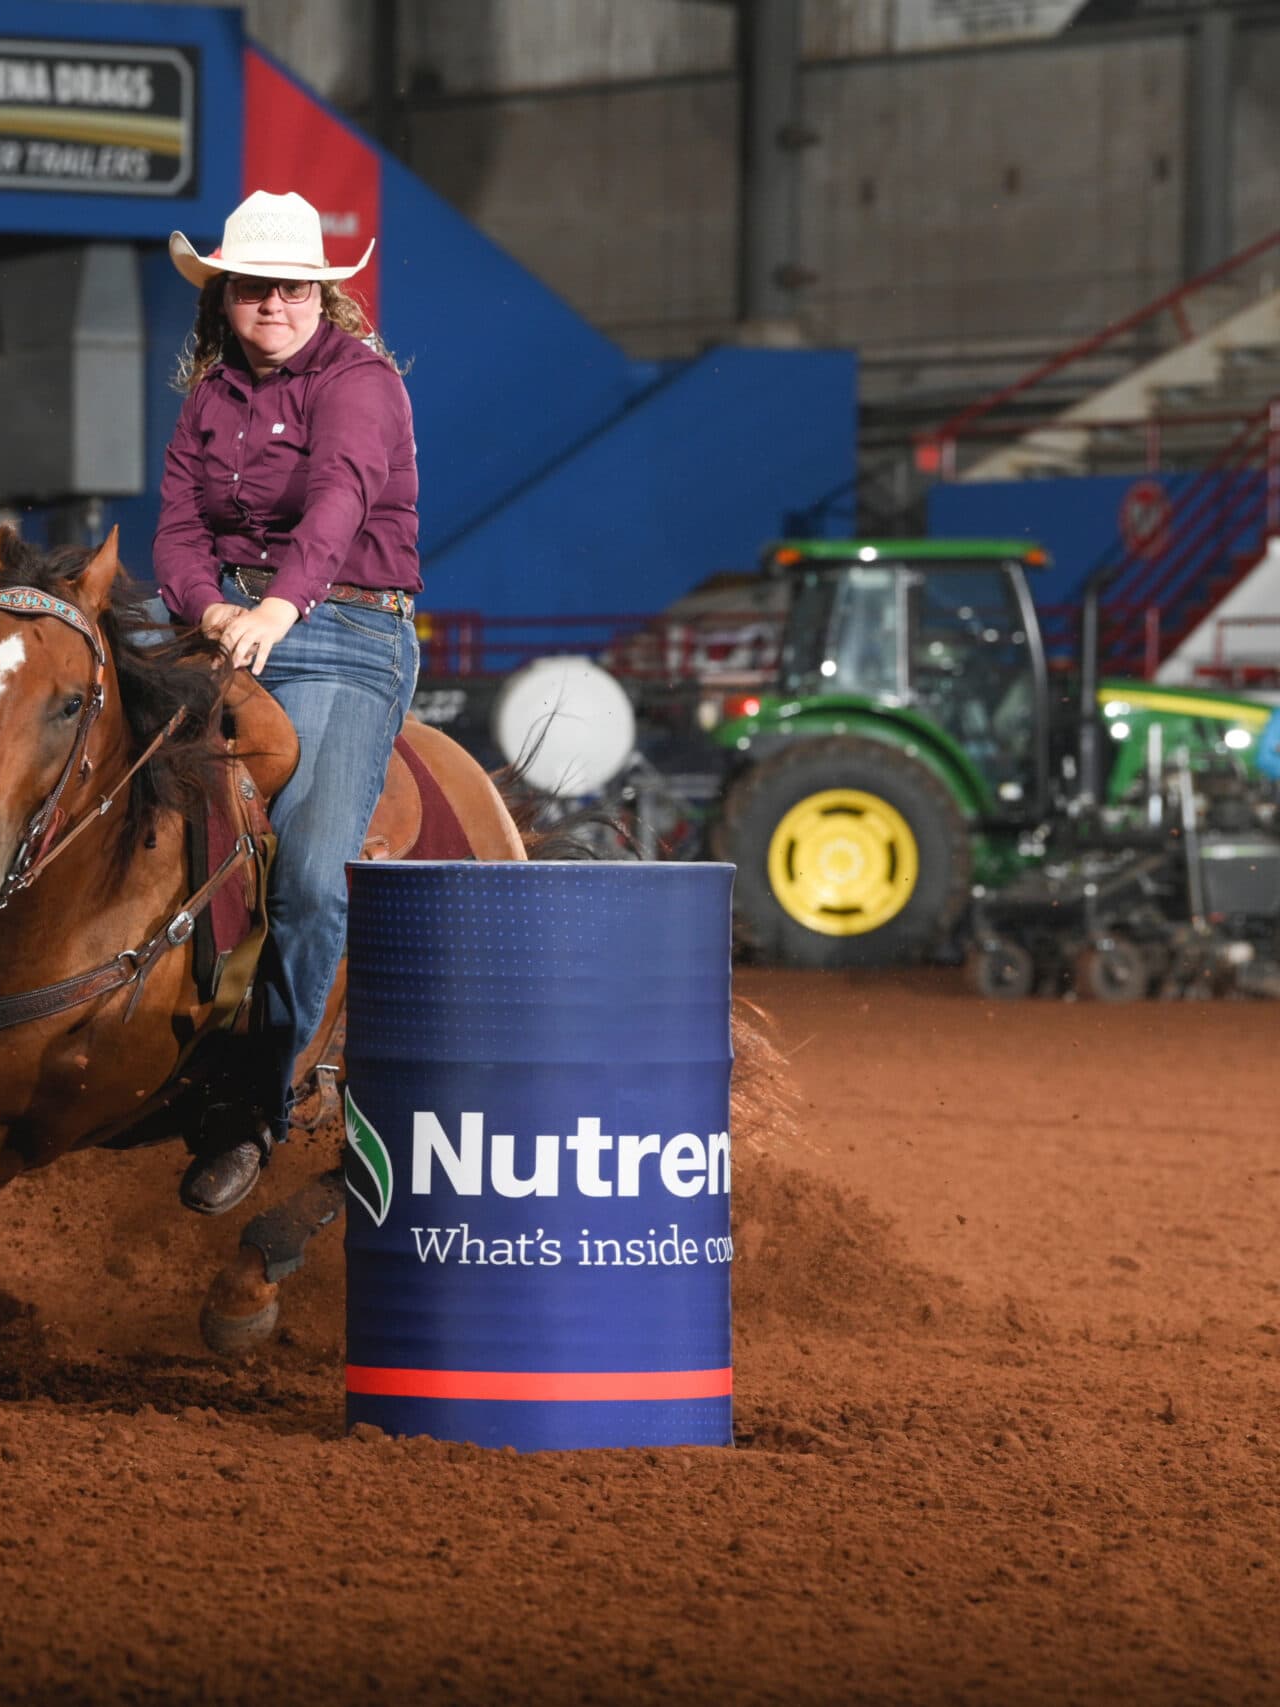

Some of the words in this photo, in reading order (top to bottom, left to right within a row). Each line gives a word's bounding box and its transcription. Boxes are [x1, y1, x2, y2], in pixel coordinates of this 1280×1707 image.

[54, 64, 153, 107] DRAGS
[24, 142, 150, 180] TRAILERS
[411, 1223, 562, 1266] What's
[578, 1224, 699, 1265] inside
